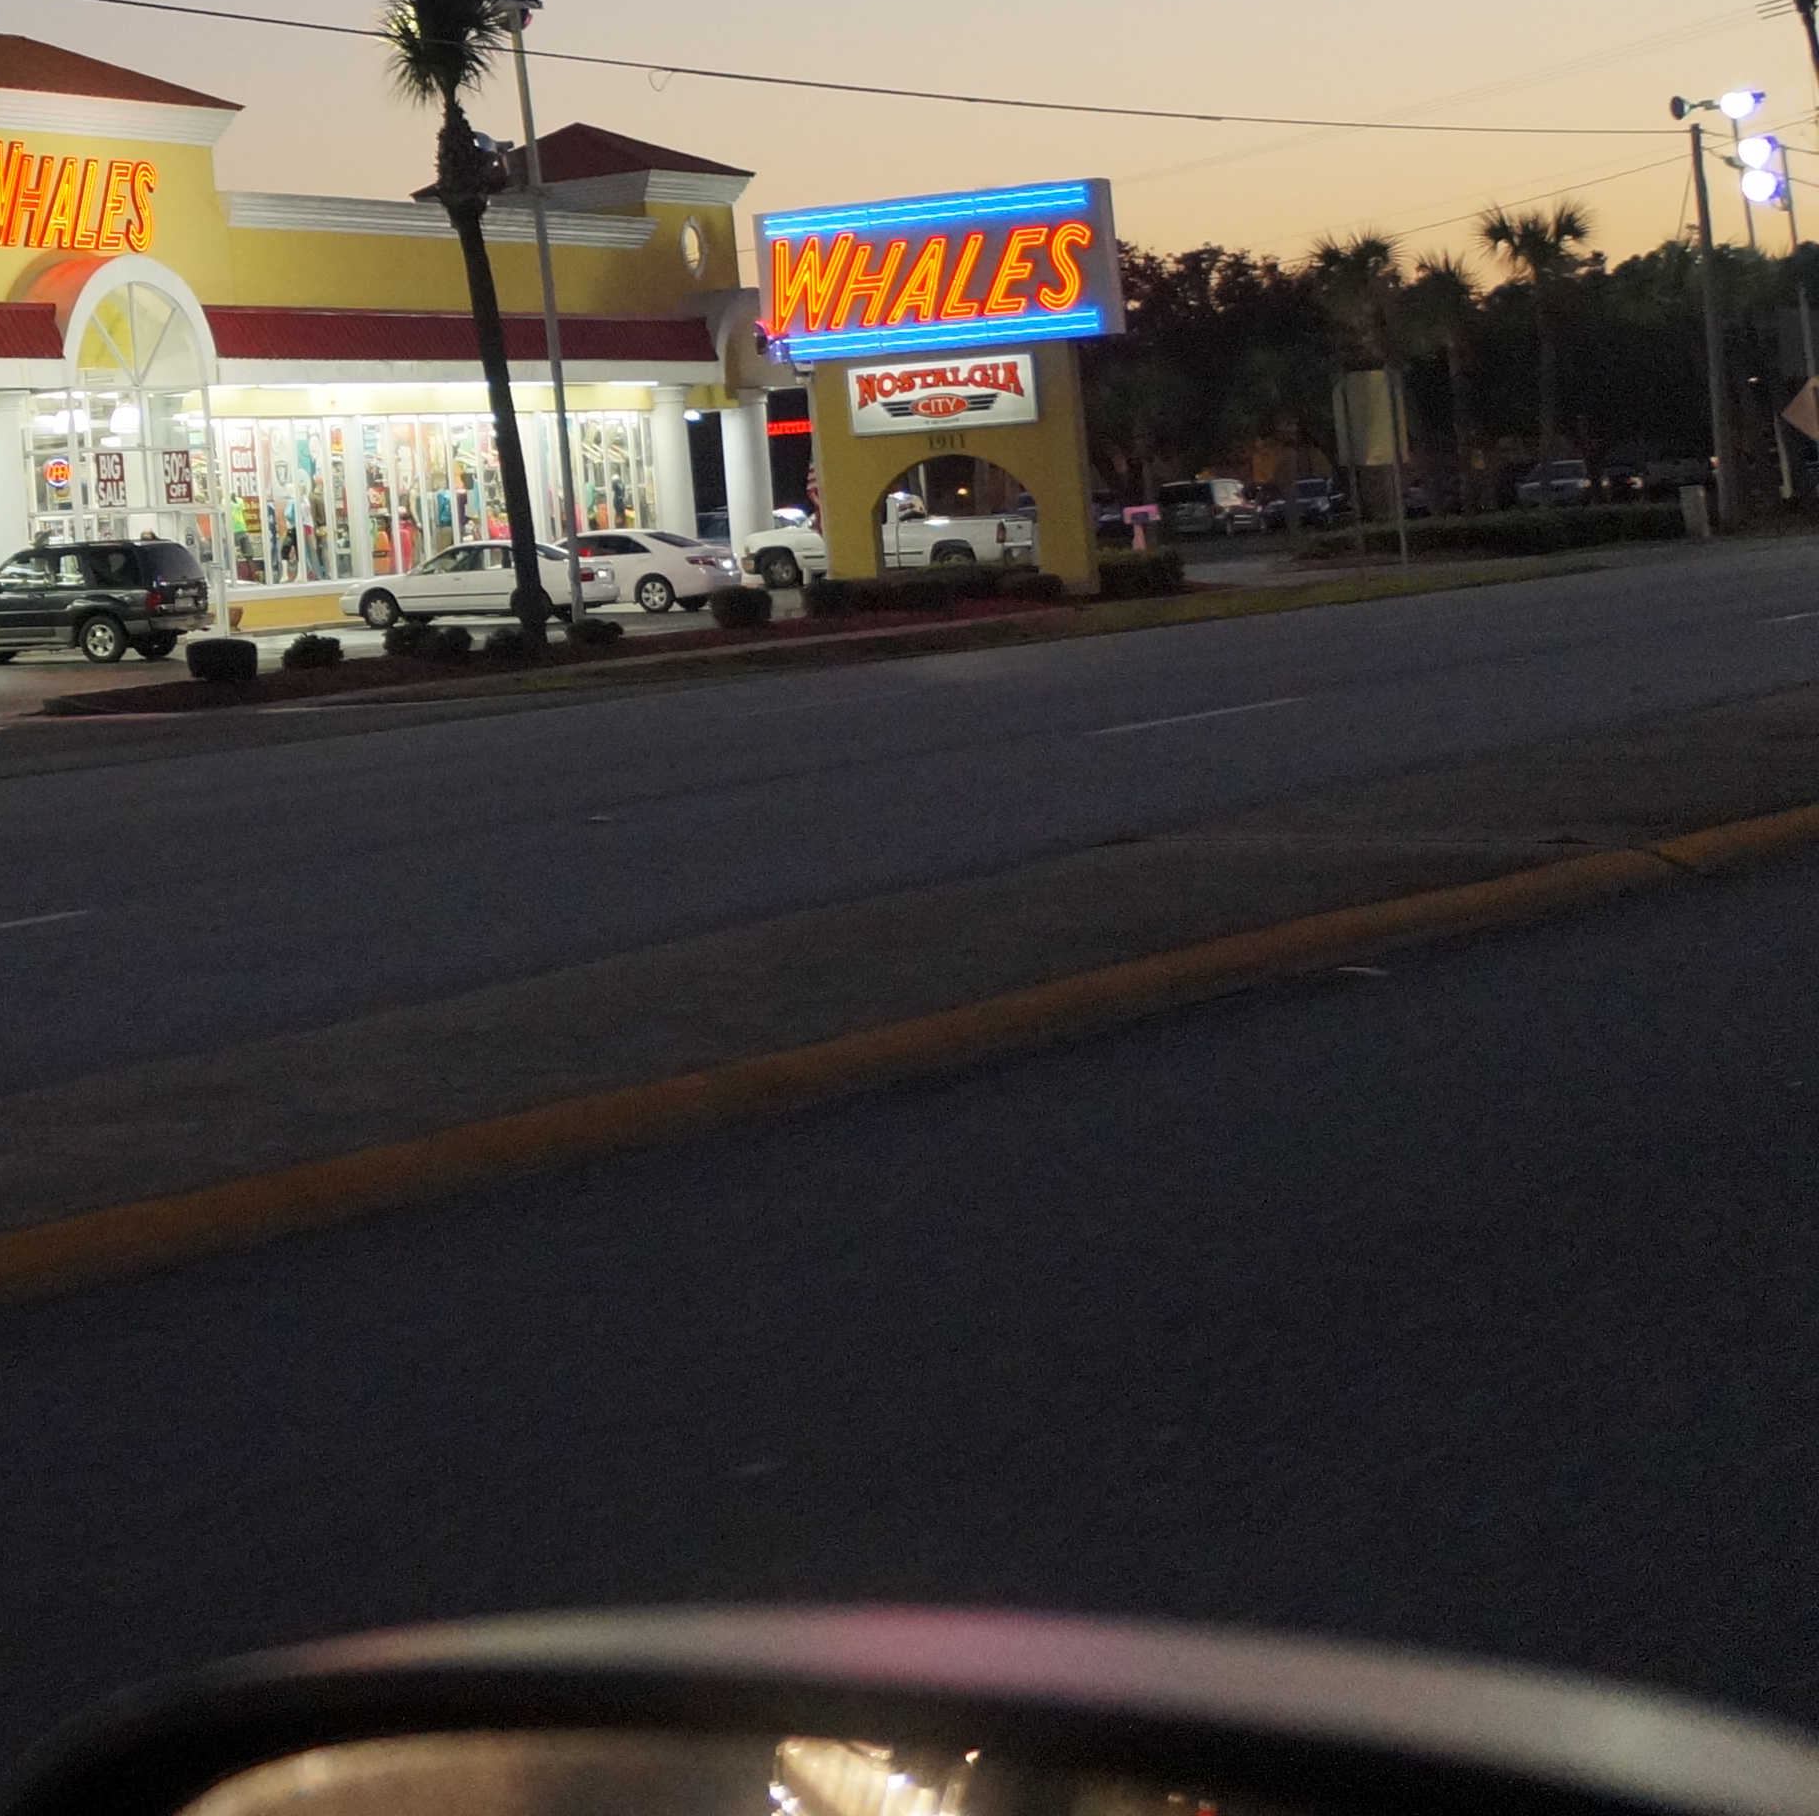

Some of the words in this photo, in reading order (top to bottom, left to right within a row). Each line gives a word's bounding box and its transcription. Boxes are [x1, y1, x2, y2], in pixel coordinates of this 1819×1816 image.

[773, 222, 1091, 331] WHALES
[856, 361, 1025, 410] NOSTALGIA
[918, 397, 957, 413] CITY
[45, 463, 72, 478] OPEN
[98, 454, 121, 480] BIG
[163, 452, 191, 484] 50%
[99, 481, 126, 507] SALE
[169, 484, 187, 497] OFF
[233, 472, 259, 497] FRE
